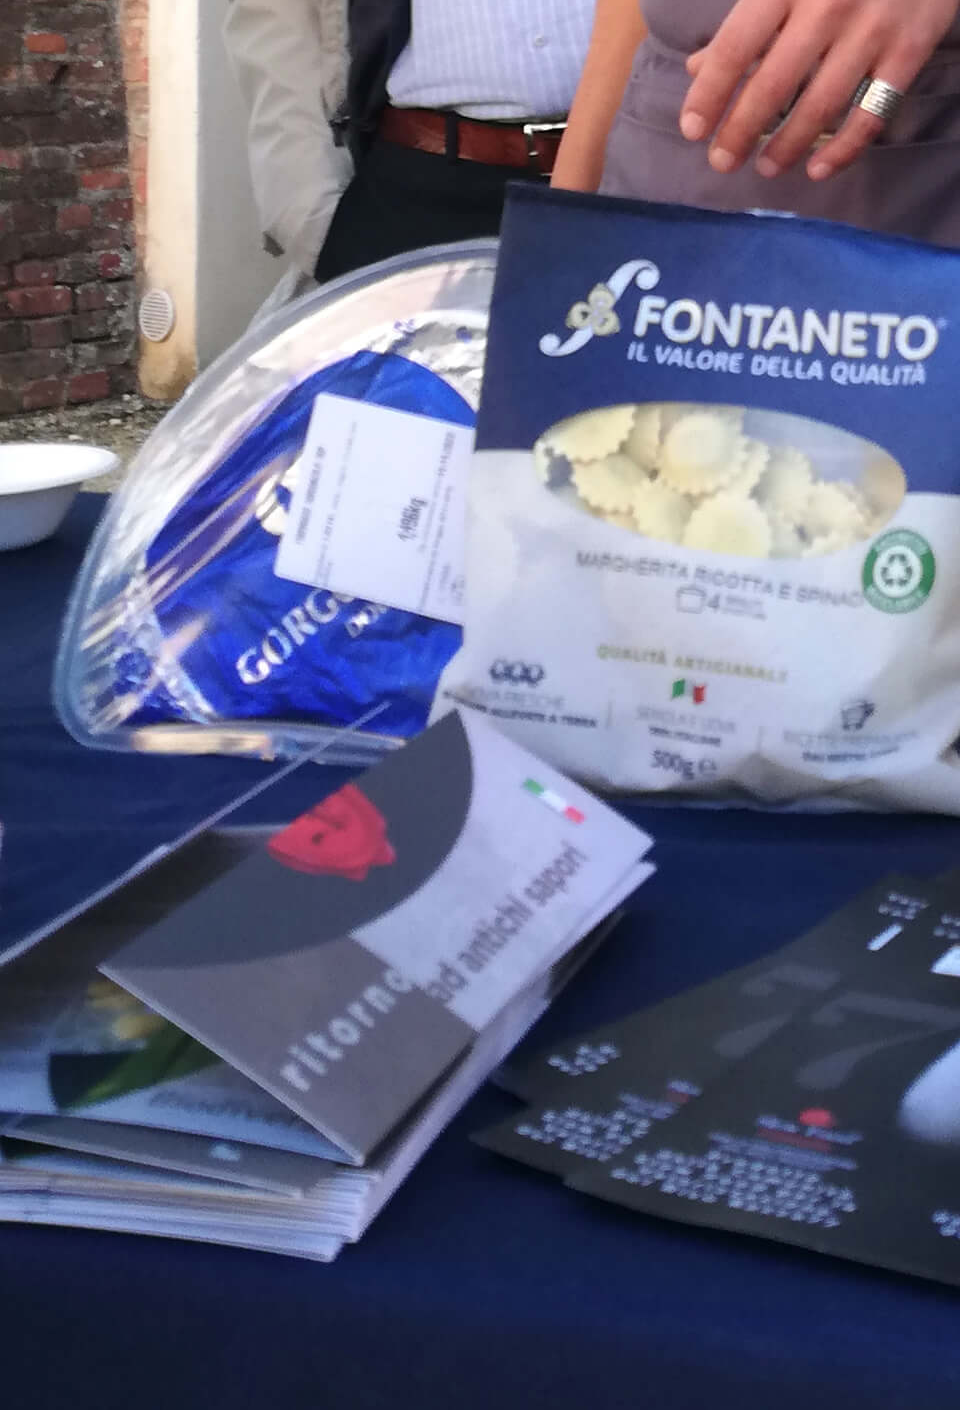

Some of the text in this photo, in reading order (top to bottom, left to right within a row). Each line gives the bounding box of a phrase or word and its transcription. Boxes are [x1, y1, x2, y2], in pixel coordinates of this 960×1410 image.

[632, 295, 940, 362] FONTANETO
[627, 342, 926, 387] IL VALORE DELLA QUALITÀ
